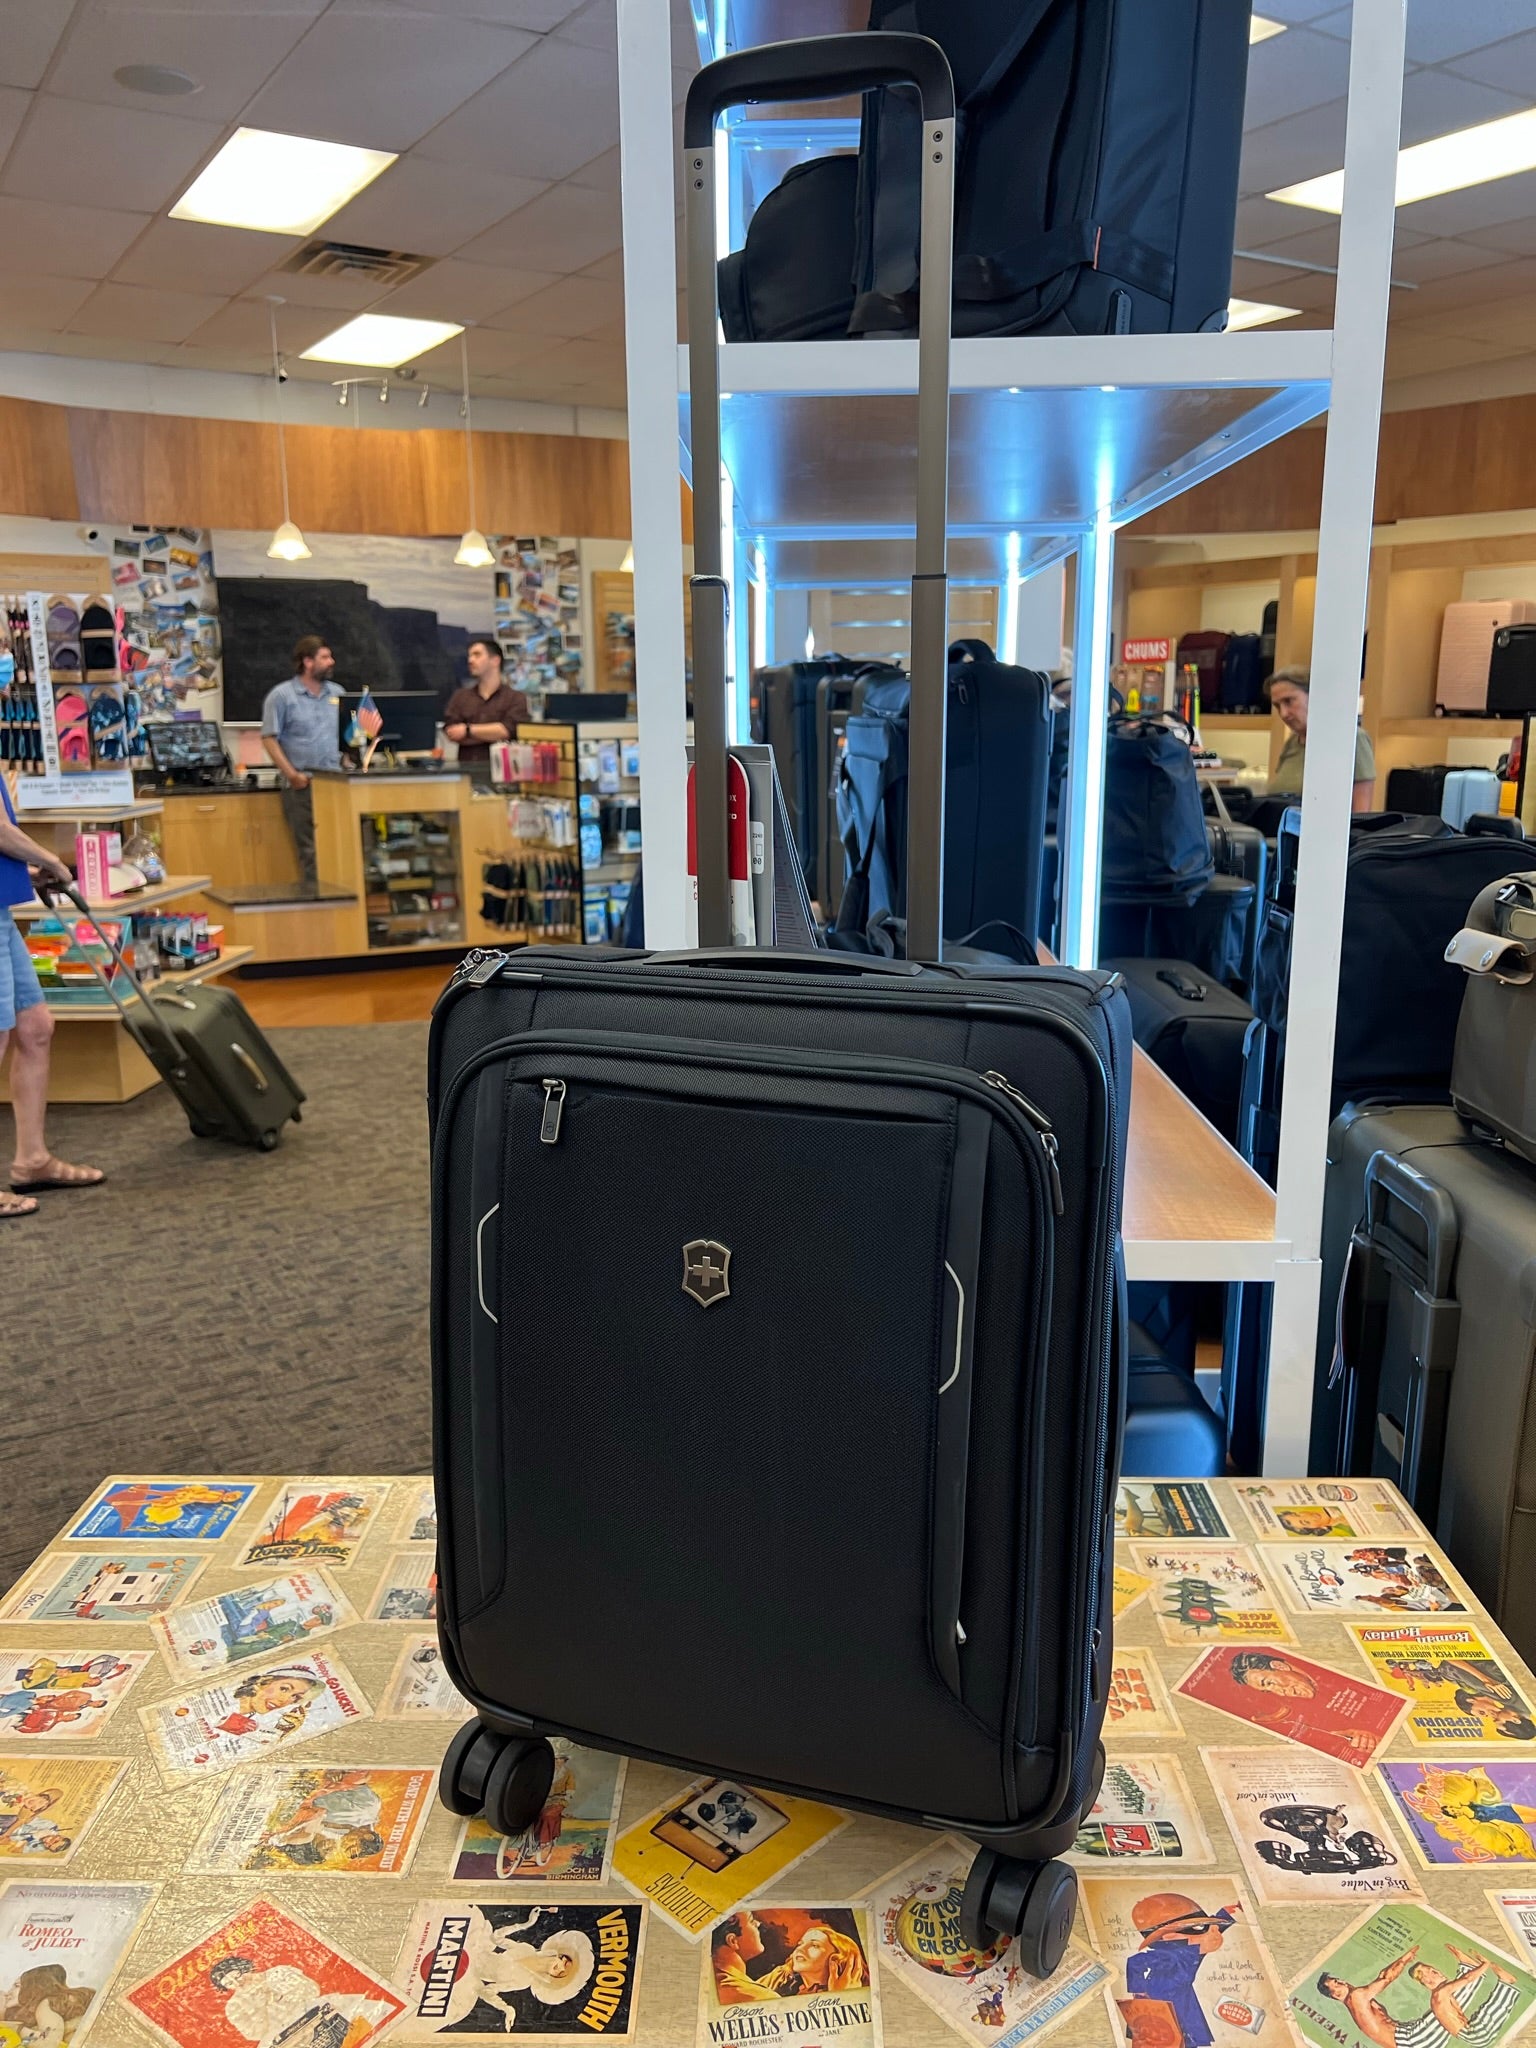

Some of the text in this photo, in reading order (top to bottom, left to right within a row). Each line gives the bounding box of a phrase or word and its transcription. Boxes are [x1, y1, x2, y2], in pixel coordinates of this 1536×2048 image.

[1125, 641, 1168, 660] CHUMS
[1237, 1613, 1272, 1621] AGE
[1363, 1626, 1421, 1642] Holiday
[1415, 1631, 1469, 1643] Roman
[1370, 1650, 1485, 1658] GREGORY PECK AUDREY HEPBURN
[332, 1685, 361, 1718] LUCKY!
[1412, 1716, 1481, 1727] HEPBURN
[1426, 1727, 1483, 1738] AUDREY
[1235, 1792, 1258, 1802] Cost
[397, 1795, 417, 1822] WITH
[391, 1822, 408, 1845] THE
[1340, 1879, 1375, 1892] Value
[1386, 1876, 1411, 1891] Big
[909, 1886, 964, 1919] LE TOUR
[913, 1919, 935, 1937] DU
[1100, 1912, 1122, 1928] Look
[18, 1924, 73, 1937] ROMEO
[420, 1921, 432, 1946] MARTINI
[29, 1937, 86, 1951] JULIET
[917, 1936, 971, 1956] EN 80
[412, 1952, 422, 1972] ROSSI
[420, 1920, 467, 2015] MARTINI
[577, 1908, 629, 2032] VERMOUTH
[1236, 1960, 1255, 1971] look
[1207, 1972, 1227, 1981] what
[807, 1996, 842, 2010] Joan
[723, 2005, 764, 2020] Orson
[1291, 1996, 1350, 2045] WEEKLY
[708, 2002, 872, 2043] WELLES FONTAINE
